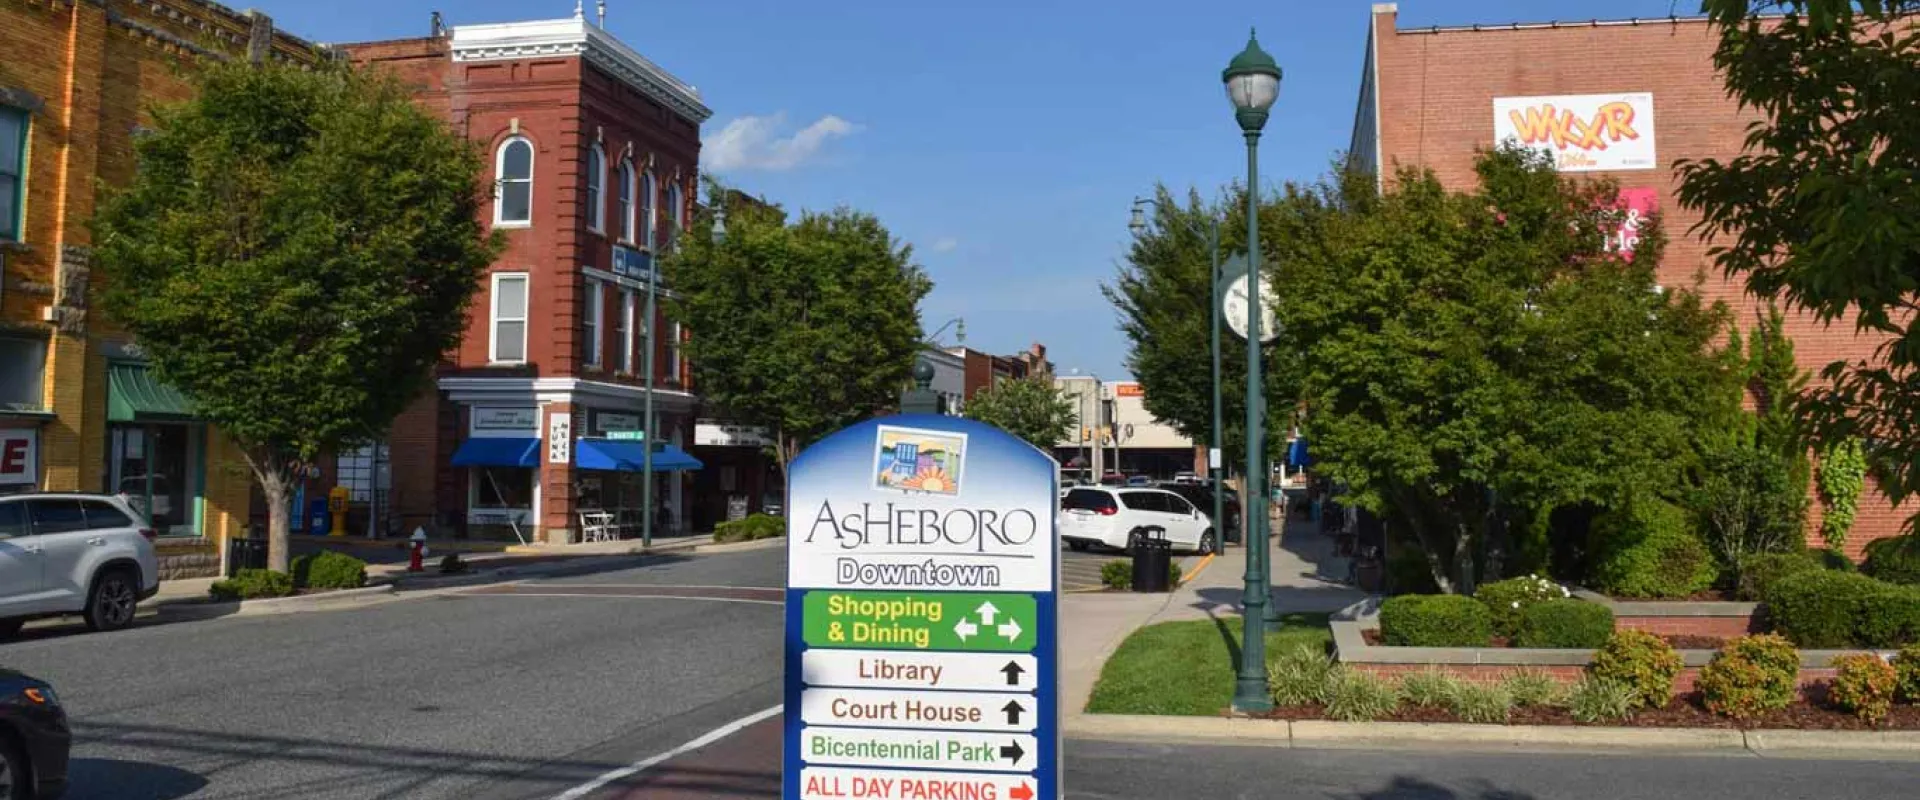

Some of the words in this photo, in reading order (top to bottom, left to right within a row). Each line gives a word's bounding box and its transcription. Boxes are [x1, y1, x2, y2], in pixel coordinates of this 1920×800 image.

[1508, 101, 1640, 151] WKXR
[837, 557, 1000, 586] Downtown
[828, 595, 943, 622] Shopping
[828, 622, 845, 643] &
[853, 622, 930, 648] Dining
[859, 658, 943, 685] Library
[831, 698, 897, 720] Court
[905, 700, 982, 722] House
[811, 736, 940, 760] Bicentennial
[947, 741, 995, 762] Park
[806, 776, 845, 797] ALL
[852, 777, 894, 799] DAY
[900, 779, 996, 800] PARKING
